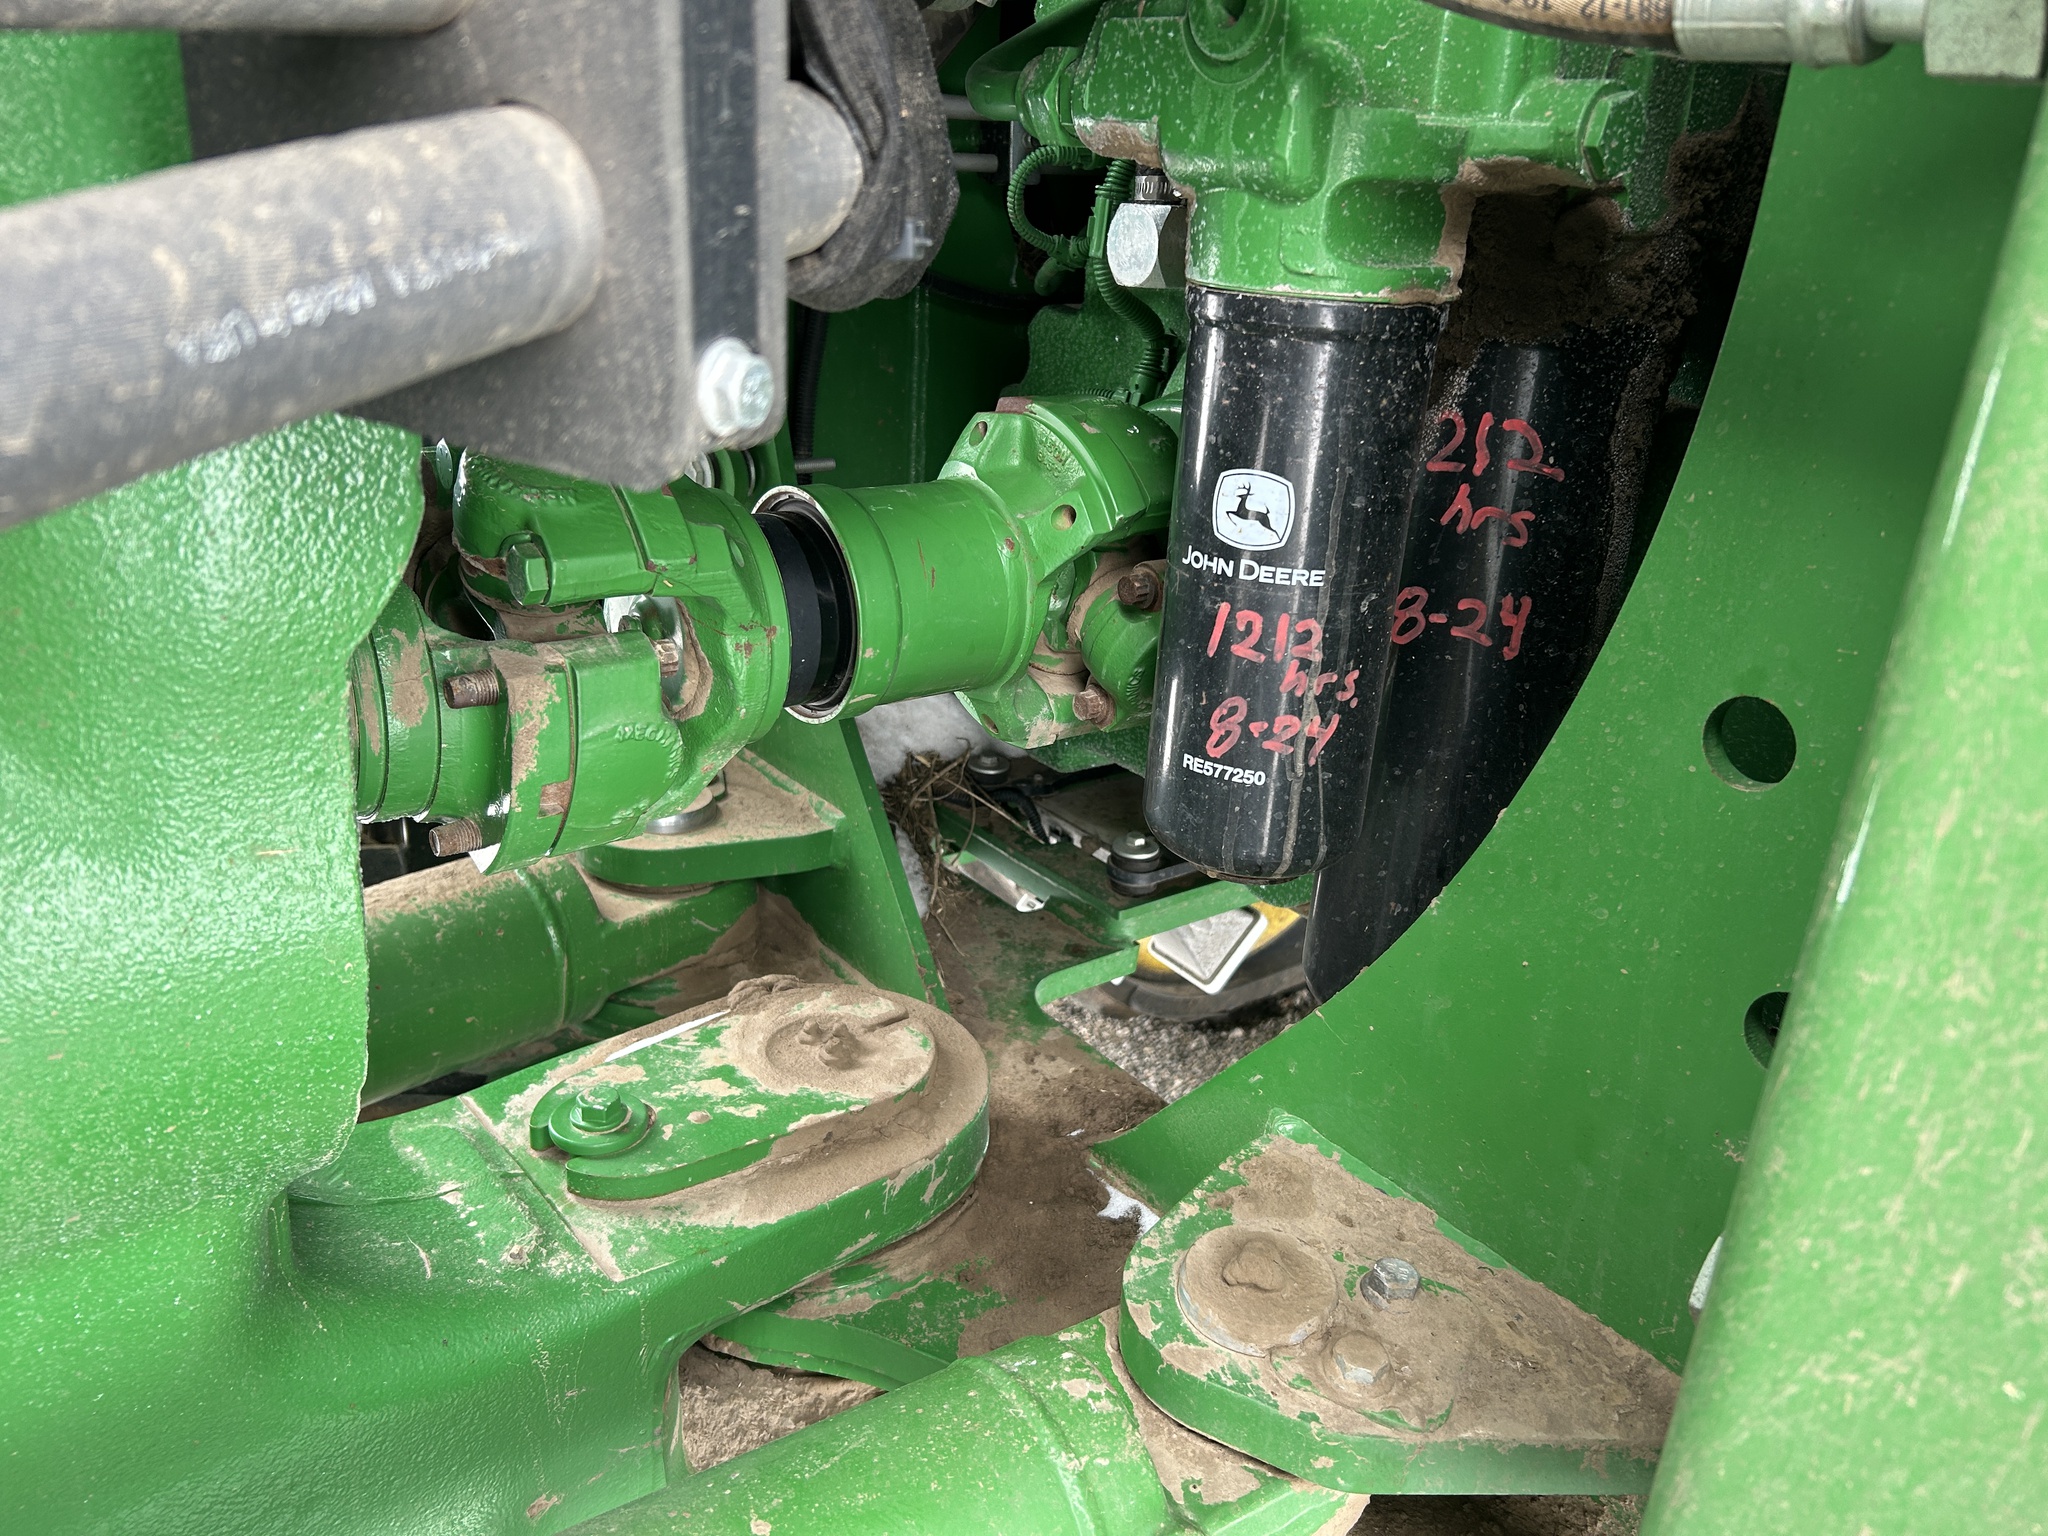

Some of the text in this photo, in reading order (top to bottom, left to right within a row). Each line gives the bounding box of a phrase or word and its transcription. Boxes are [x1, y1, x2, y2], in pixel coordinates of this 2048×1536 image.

[1440, 483, 1535, 548] hrs
[1182, 545, 1326, 587] JOHN DEERE
[1207, 602, 1324, 663] 1212
[1390, 586, 1532, 660] 8-24
[1205, 696, 1340, 766] 8-24
[1182, 753, 1267, 786] RE577250
